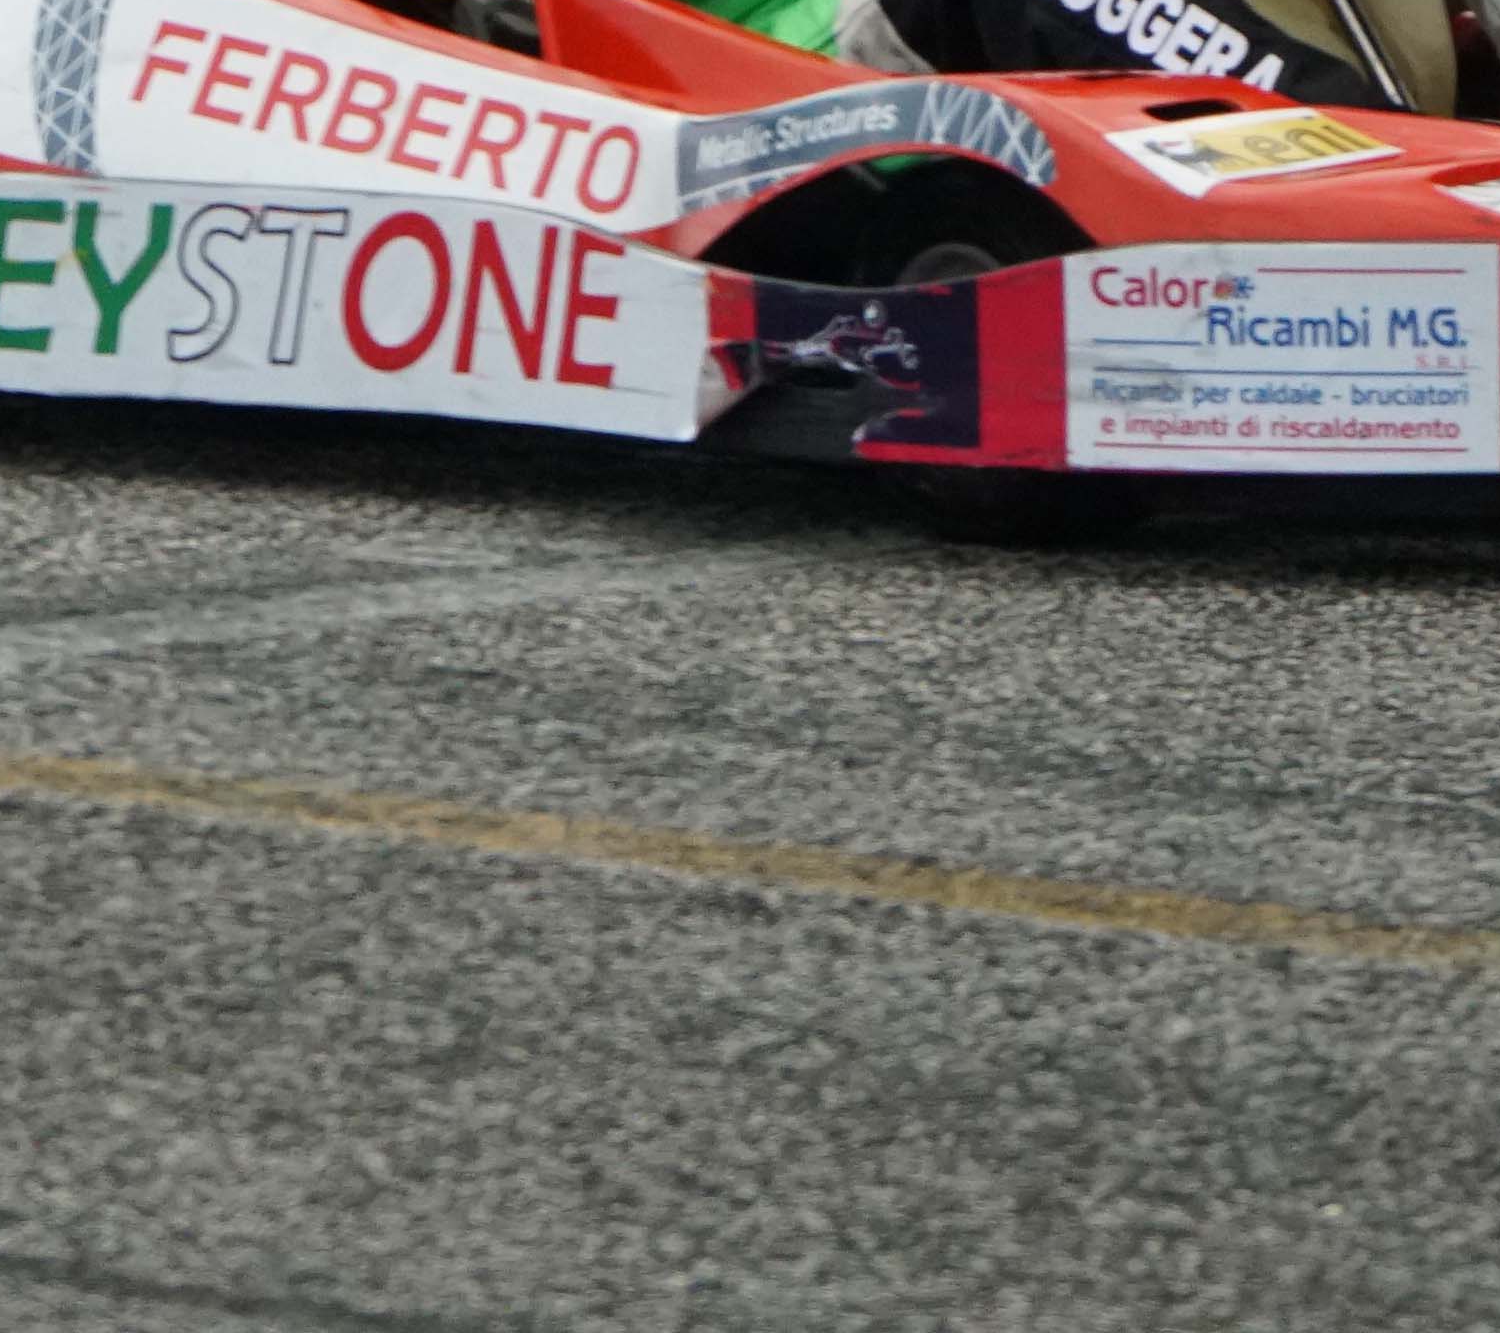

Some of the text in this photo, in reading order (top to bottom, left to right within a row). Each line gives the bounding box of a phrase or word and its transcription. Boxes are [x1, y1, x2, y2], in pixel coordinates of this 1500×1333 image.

[130, 21, 642, 215] FERBERTO
[695, 101, 900, 167] Metallic Structures
[1090, 267, 1209, 309] Calor
[1206, 305, 1469, 349] Ricambi M.G.
[1091, 378, 1182, 401] Ricambi
[1191, 386, 1233, 409] per
[1239, 380, 1323, 406] caldaie
[1350, 383, 1471, 408] bruciatori
[1101, 416, 1462, 441] e impianti di riscaldamento
